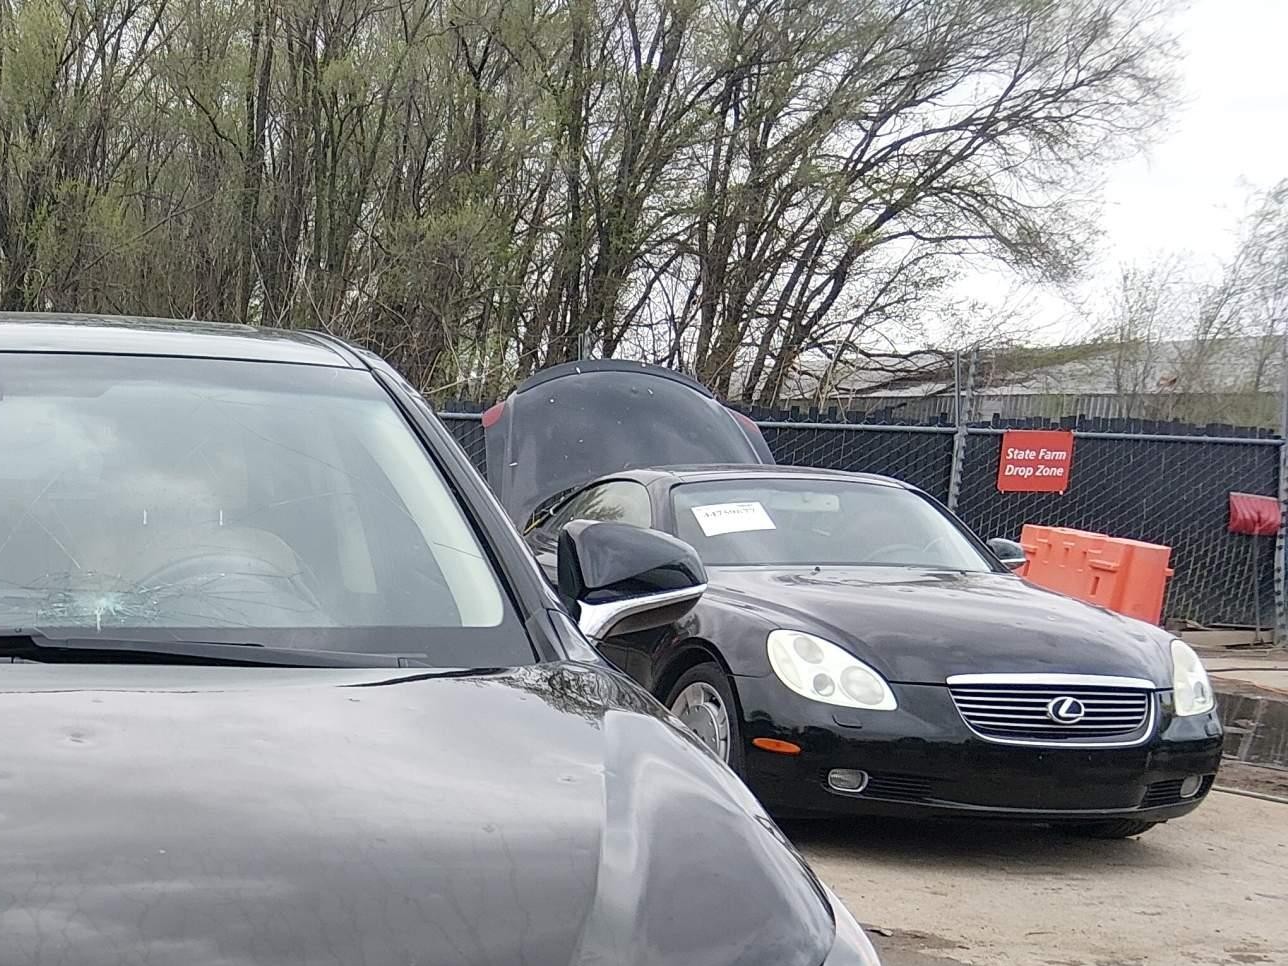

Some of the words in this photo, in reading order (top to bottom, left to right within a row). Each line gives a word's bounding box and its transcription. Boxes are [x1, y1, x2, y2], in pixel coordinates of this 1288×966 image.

[1006, 447, 1036, 460] State
[1038, 448, 1067, 460] Farm
[1004, 464, 1033, 478] Drop
[1035, 464, 1064, 476] Zone
